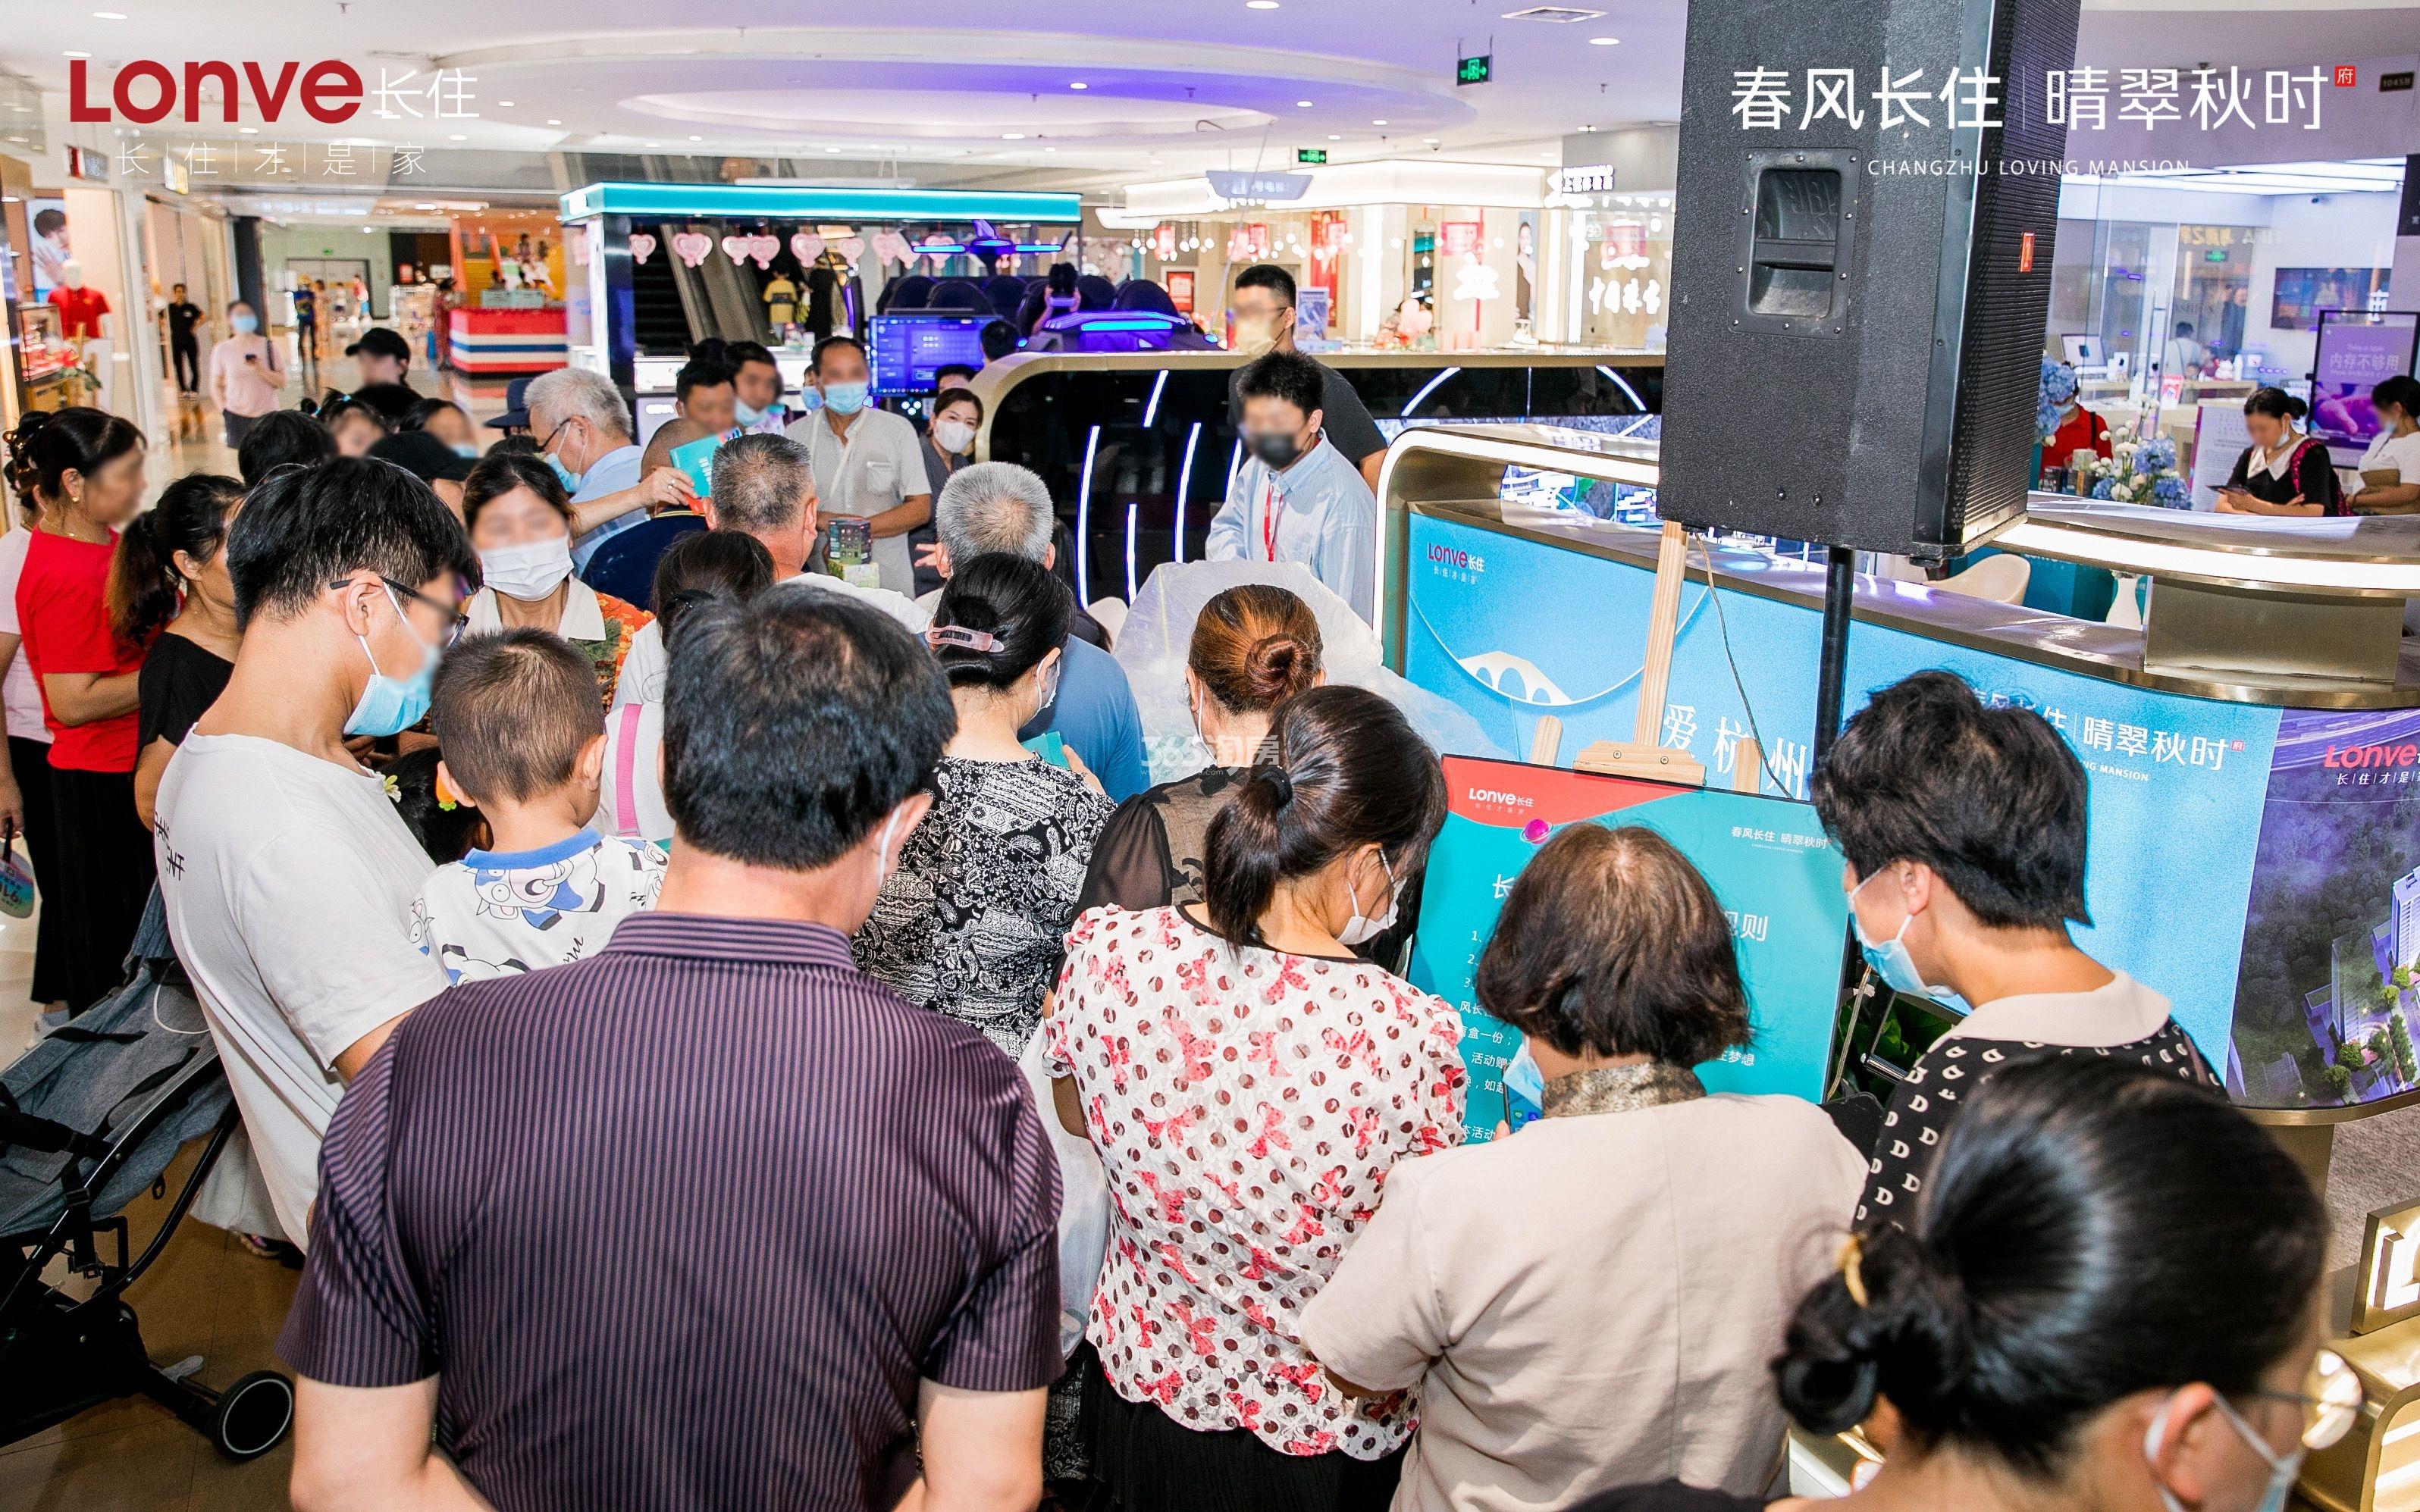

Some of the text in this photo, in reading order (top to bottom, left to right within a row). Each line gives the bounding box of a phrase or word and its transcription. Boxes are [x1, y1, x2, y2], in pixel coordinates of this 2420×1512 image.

[1427, 542, 1468, 568] Lonve
[2083, 715, 2229, 772] 晴翠秋时
[2324, 743, 2417, 769] Lonve
[2099, 764, 2149, 782] MANSION
[1469, 787, 1534, 808] Lonve 长住
[1732, 826, 1829, 850] 春风长住 晴翠秋时
[1459, 1000, 1492, 1017] 风长
